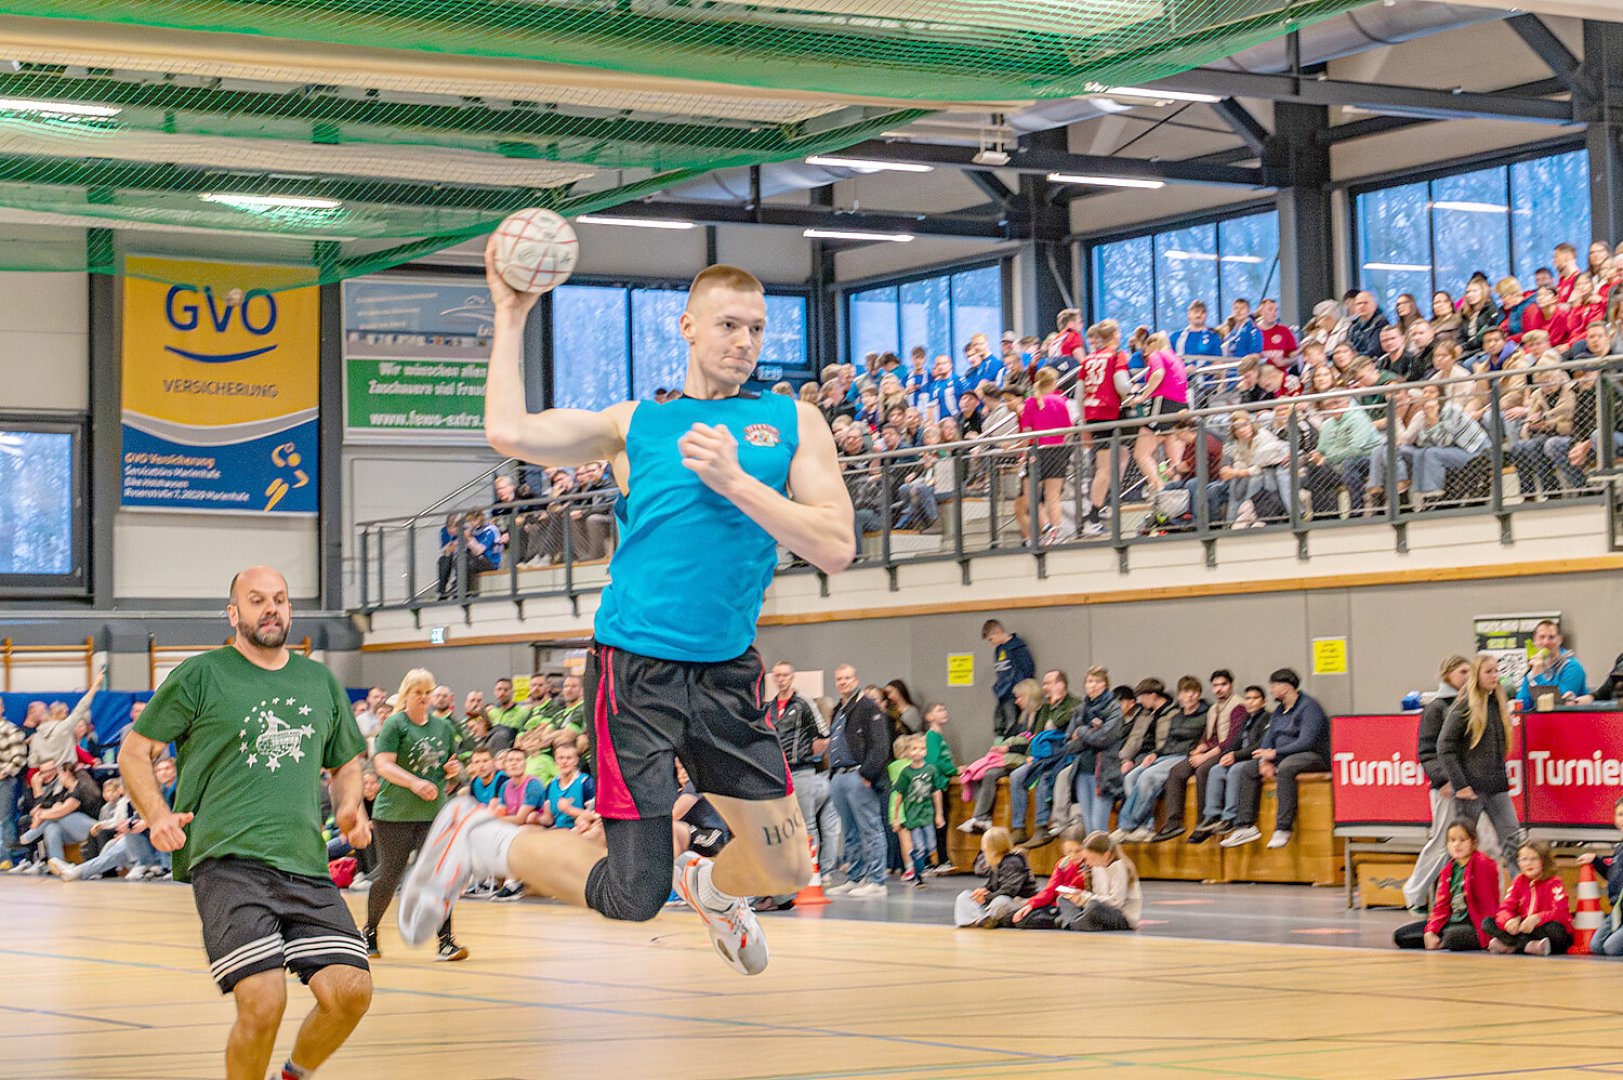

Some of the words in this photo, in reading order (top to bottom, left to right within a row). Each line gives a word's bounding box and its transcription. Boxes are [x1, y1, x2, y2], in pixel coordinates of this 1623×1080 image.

[165, 284, 278, 336] GVO
[379, 361, 402, 376] Wir
[163, 378, 279, 399] VERSICHERUNG
[1333, 751, 1430, 787] Turnier
[1528, 749, 1623, 787] Turnie
